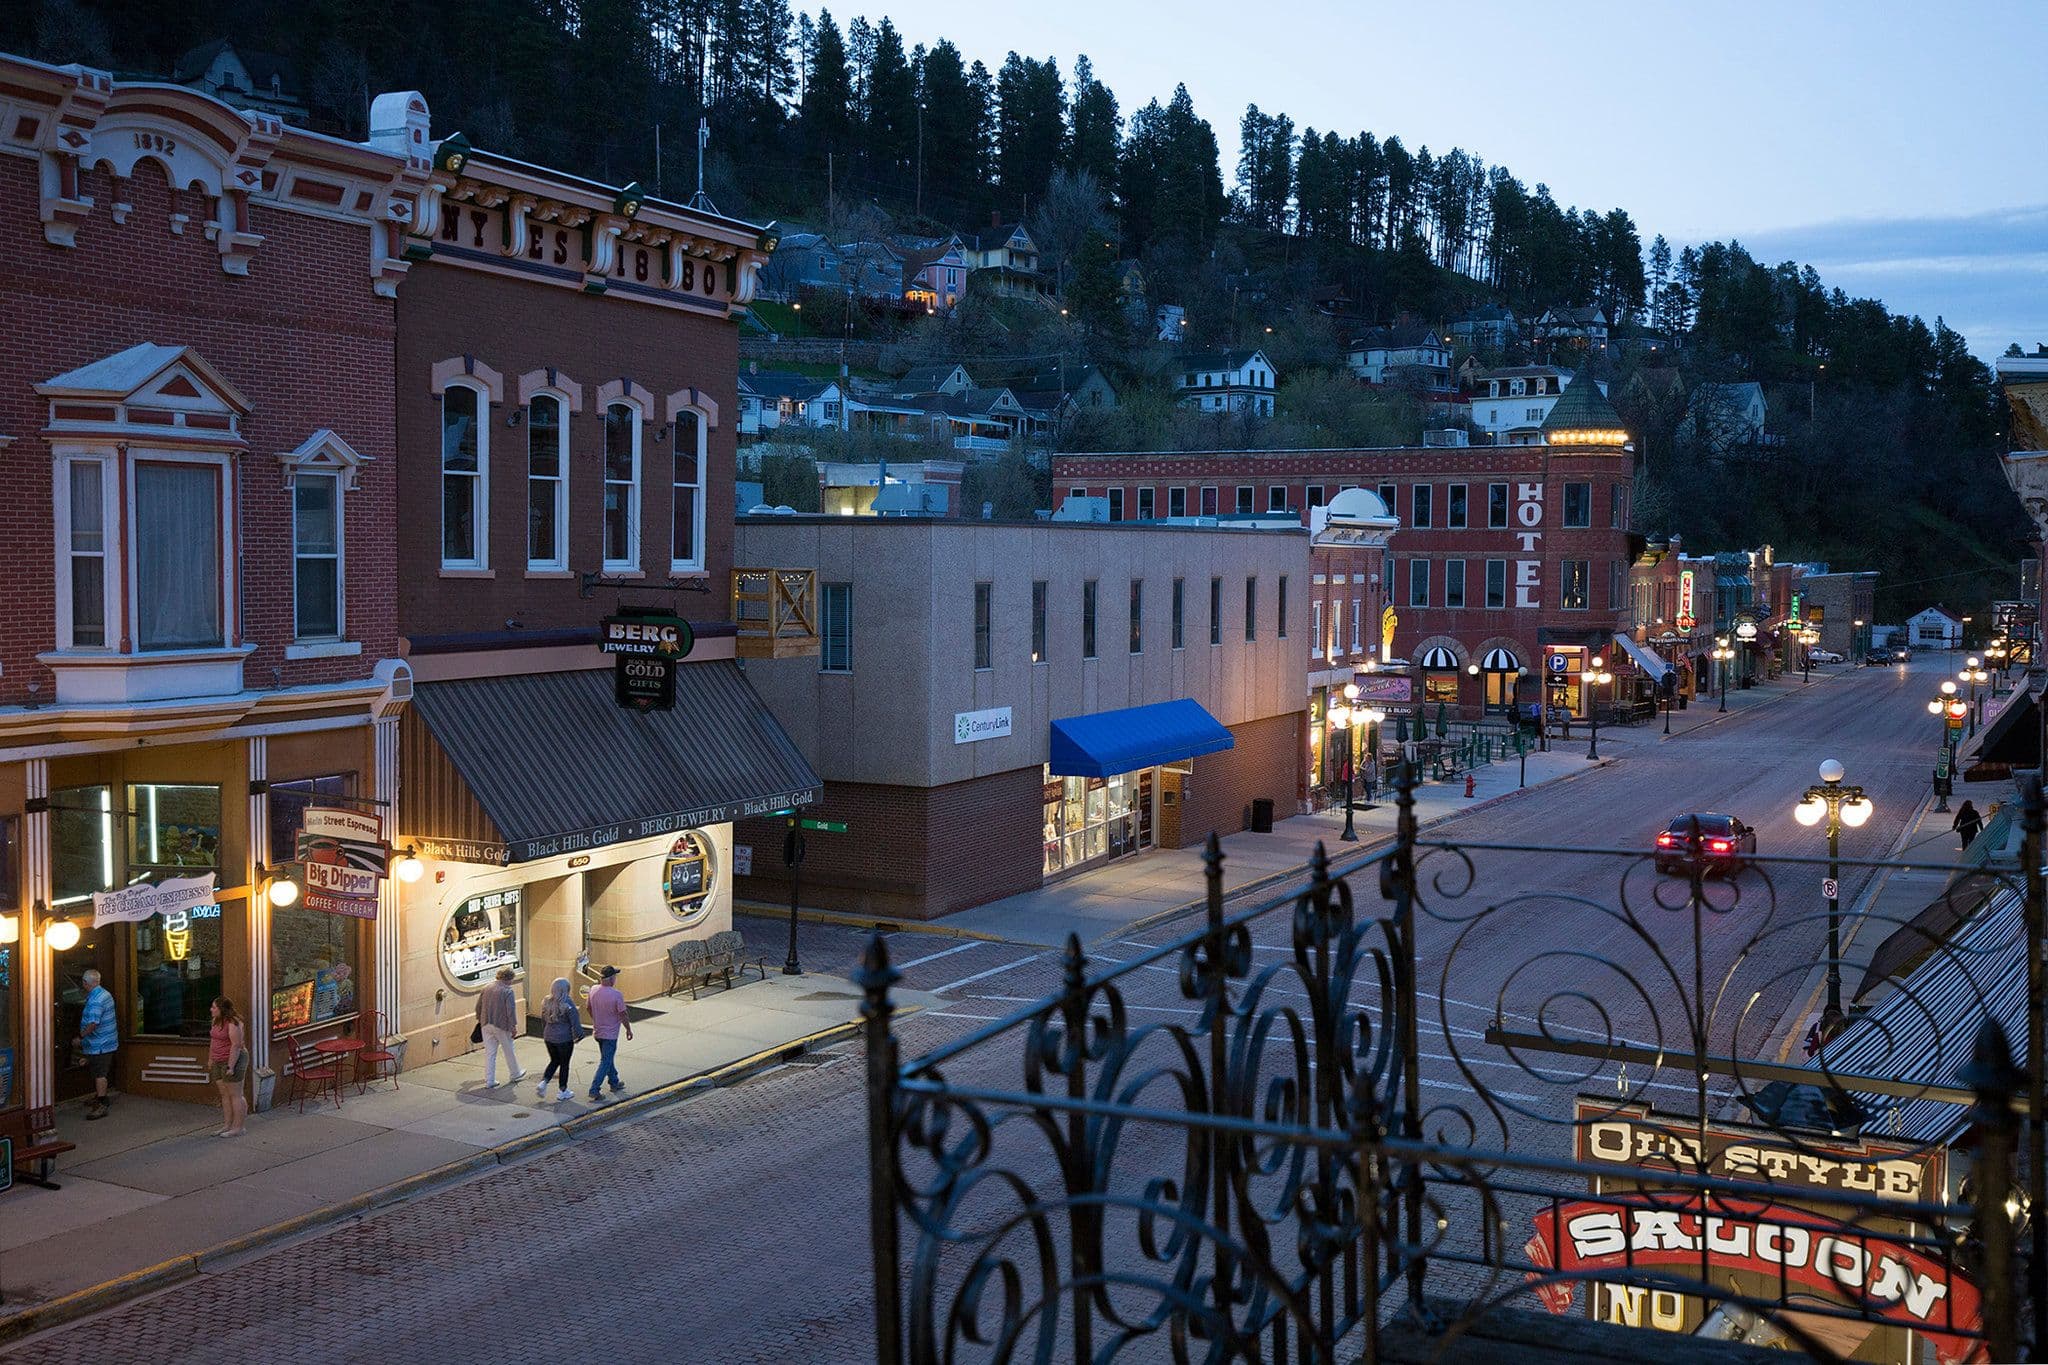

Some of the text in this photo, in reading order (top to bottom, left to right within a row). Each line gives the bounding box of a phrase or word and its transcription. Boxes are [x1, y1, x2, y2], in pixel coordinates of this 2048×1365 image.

[134, 132, 176, 158] 1892
[616, 244, 716, 297] 1880
[1515, 483, 1544, 608] HOTEL
[609, 623, 678, 642] BERG
[603, 642, 656, 654] JEWELRY
[625, 664, 666, 678] GOLD
[1553, 656, 1564, 669] P
[629, 679, 661, 689] GIFTS
[1394, 706, 1412, 714] BLING
[972, 716, 1009, 732] CenturyLink
[744, 790, 813, 816] Black Hills Gold
[323, 815, 346, 826] Street
[346, 817, 377, 835] Espresso
[640, 806, 727, 836] BERG JEWELRY
[423, 841, 511, 862] Black Hills Gold
[527, 827, 619, 858] Black Hills Gold
[572, 857, 588, 866] 650
[309, 863, 373, 892] Big Dipper
[97, 903, 116, 916] ICE
[116, 894, 158, 913] CREAM
[160, 885, 212, 906] ESPRESSO
[306, 896, 374, 915] COFFEE ICE CREAM
[1589, 1121, 1922, 1202] OLD STYLE
[1567, 1209, 1948, 1320] SALOON
[1604, 1282, 1685, 1332] NO
